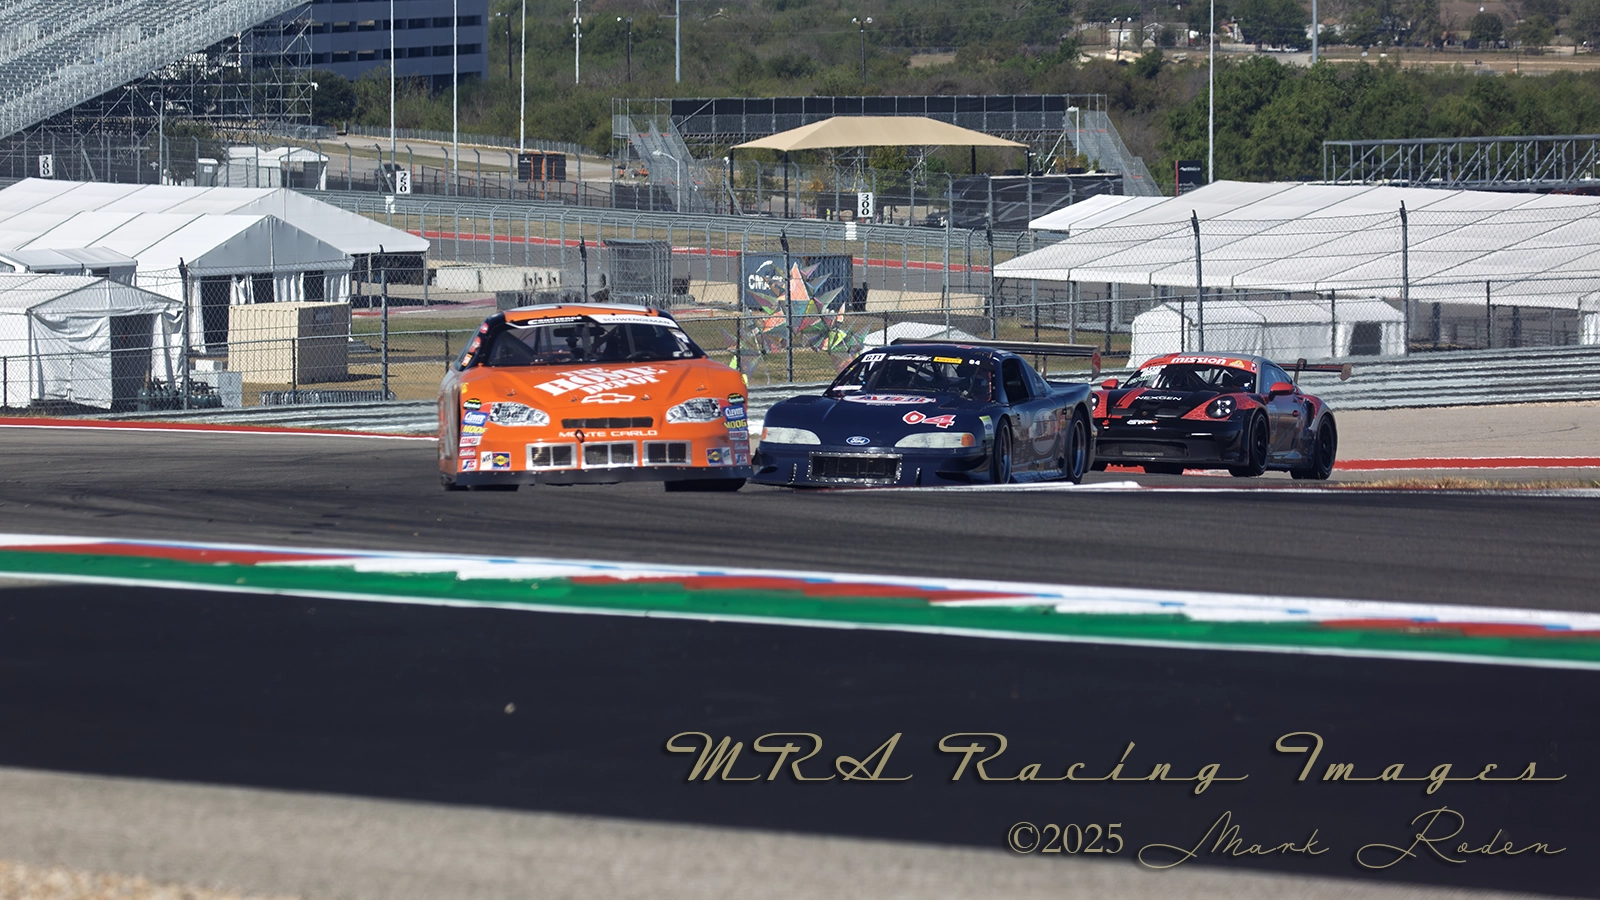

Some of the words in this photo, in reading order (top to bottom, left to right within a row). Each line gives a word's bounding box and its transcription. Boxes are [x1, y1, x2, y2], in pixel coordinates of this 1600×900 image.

[42, 156, 50, 175] 200
[399, 172, 407, 192] 250
[861, 194, 870, 216] 300
[1170, 356, 1227, 366] mission
[533, 366, 668, 396] HOME
[558, 367, 604, 377] THE
[579, 375, 660, 395] DEPOT
[723, 419, 747, 429] MOOG
[902, 410, 957, 429] 04
[610, 429, 658, 437] CARLO
